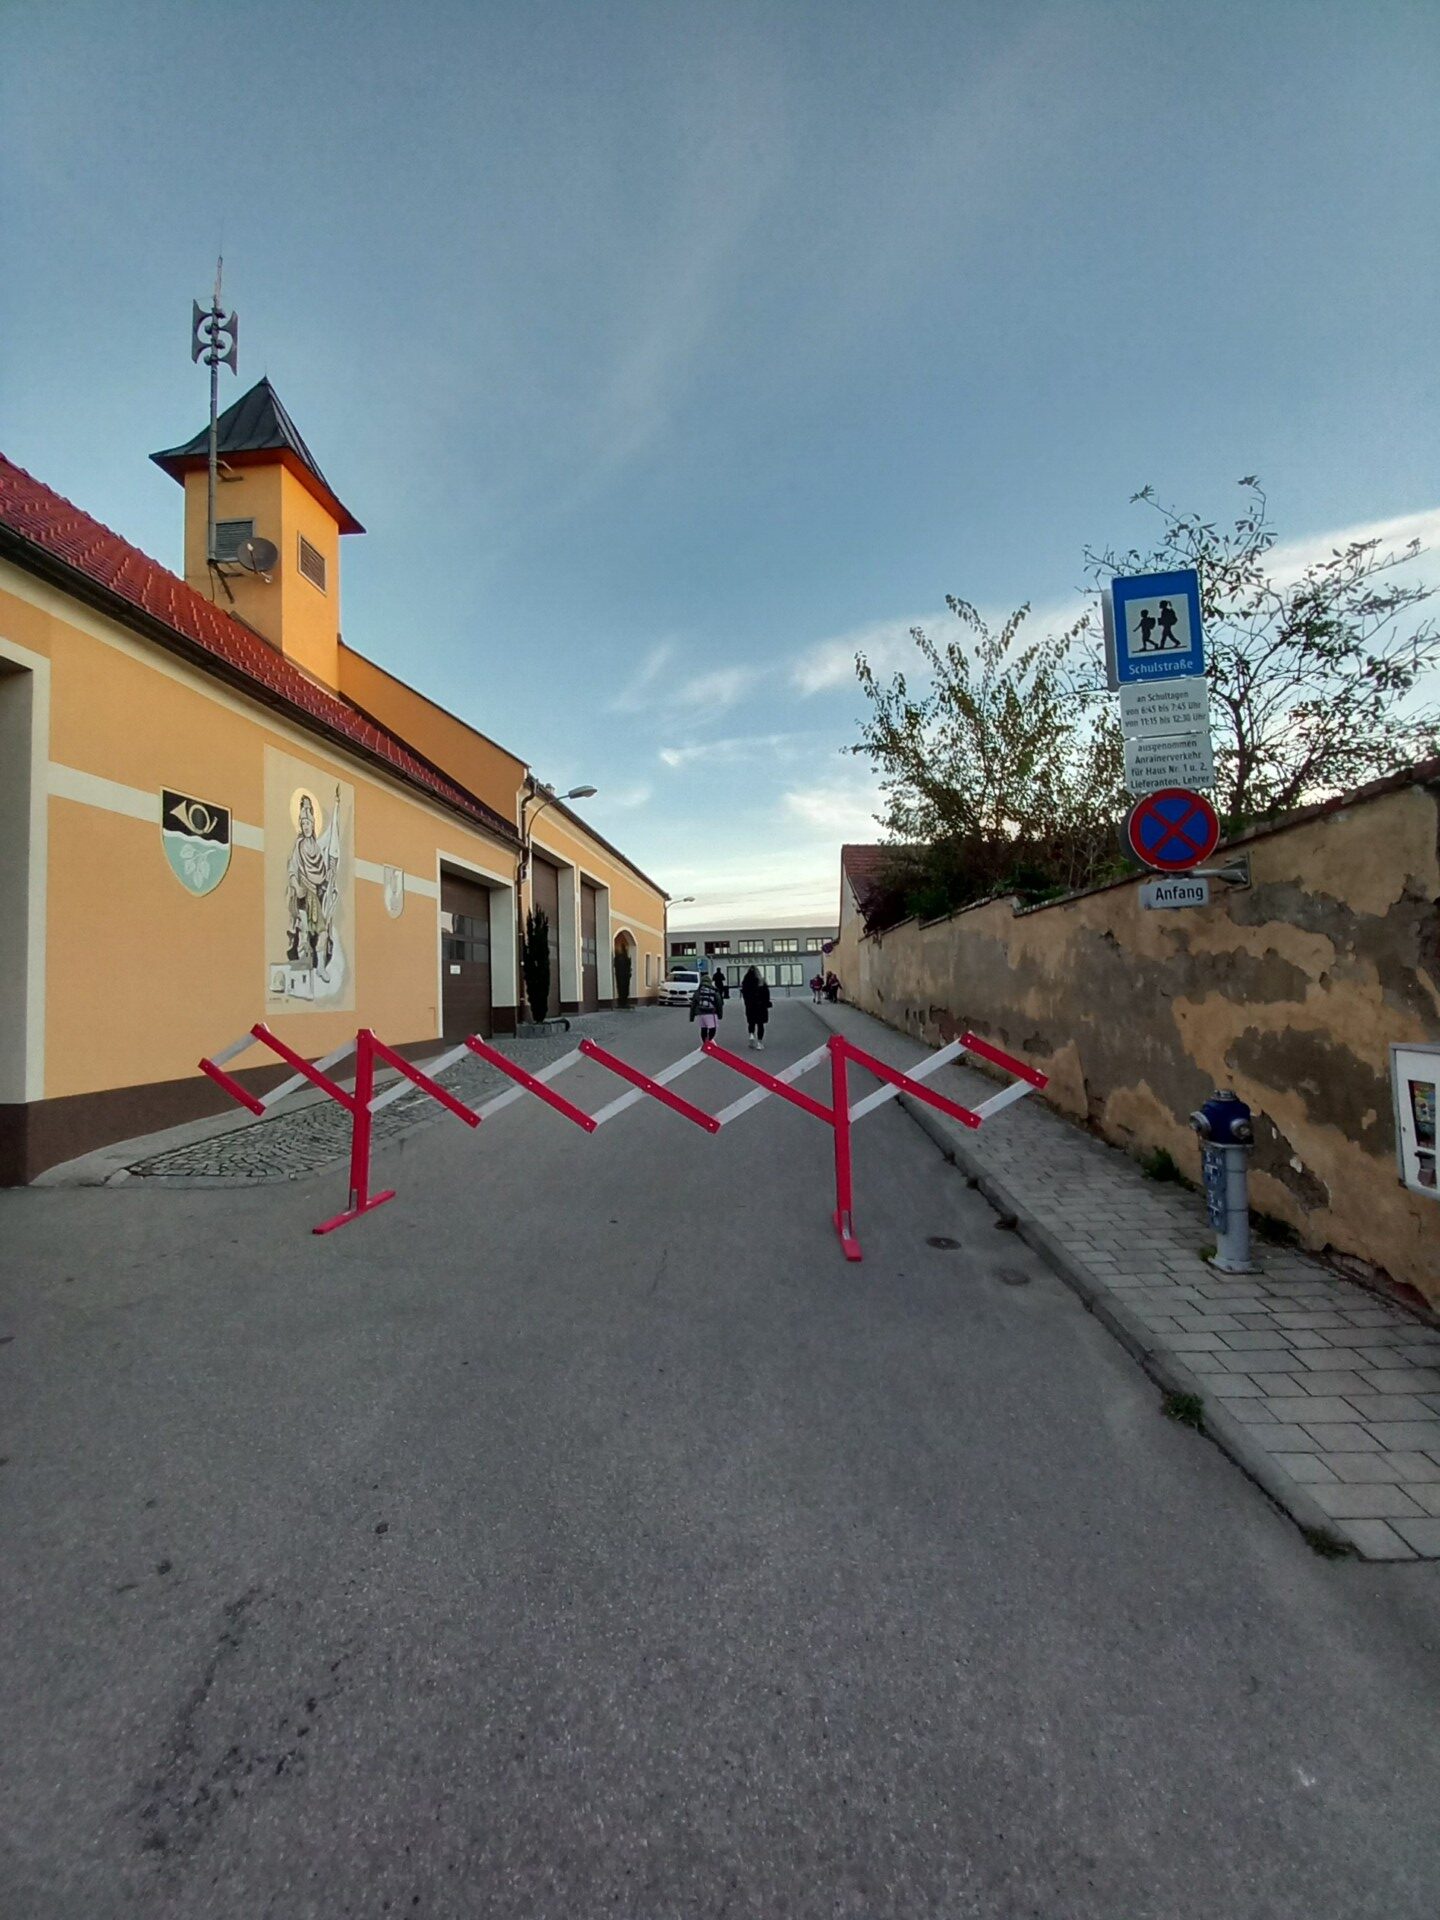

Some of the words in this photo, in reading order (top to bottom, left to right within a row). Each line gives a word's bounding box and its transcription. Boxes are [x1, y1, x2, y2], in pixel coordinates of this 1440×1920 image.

[1129, 659, 1194, 675] Schulstraße
[1147, 691, 1189, 703] Schultagen
[1126, 707, 1139, 716] von
[1158, 704, 1169, 712] bis
[1188, 701, 1201, 709] Uhr
[1125, 719, 1138, 727] von
[1159, 716, 1170, 724] bis
[1138, 740, 1197, 752] ausgenommen
[1135, 751, 1201, 764] Anrainerverkehr
[1131, 768, 1143, 777] für
[1146, 766, 1166, 775] Haus
[1183, 775, 1209, 785] Lehrer
[1156, 886, 1204, 901] Anfang
